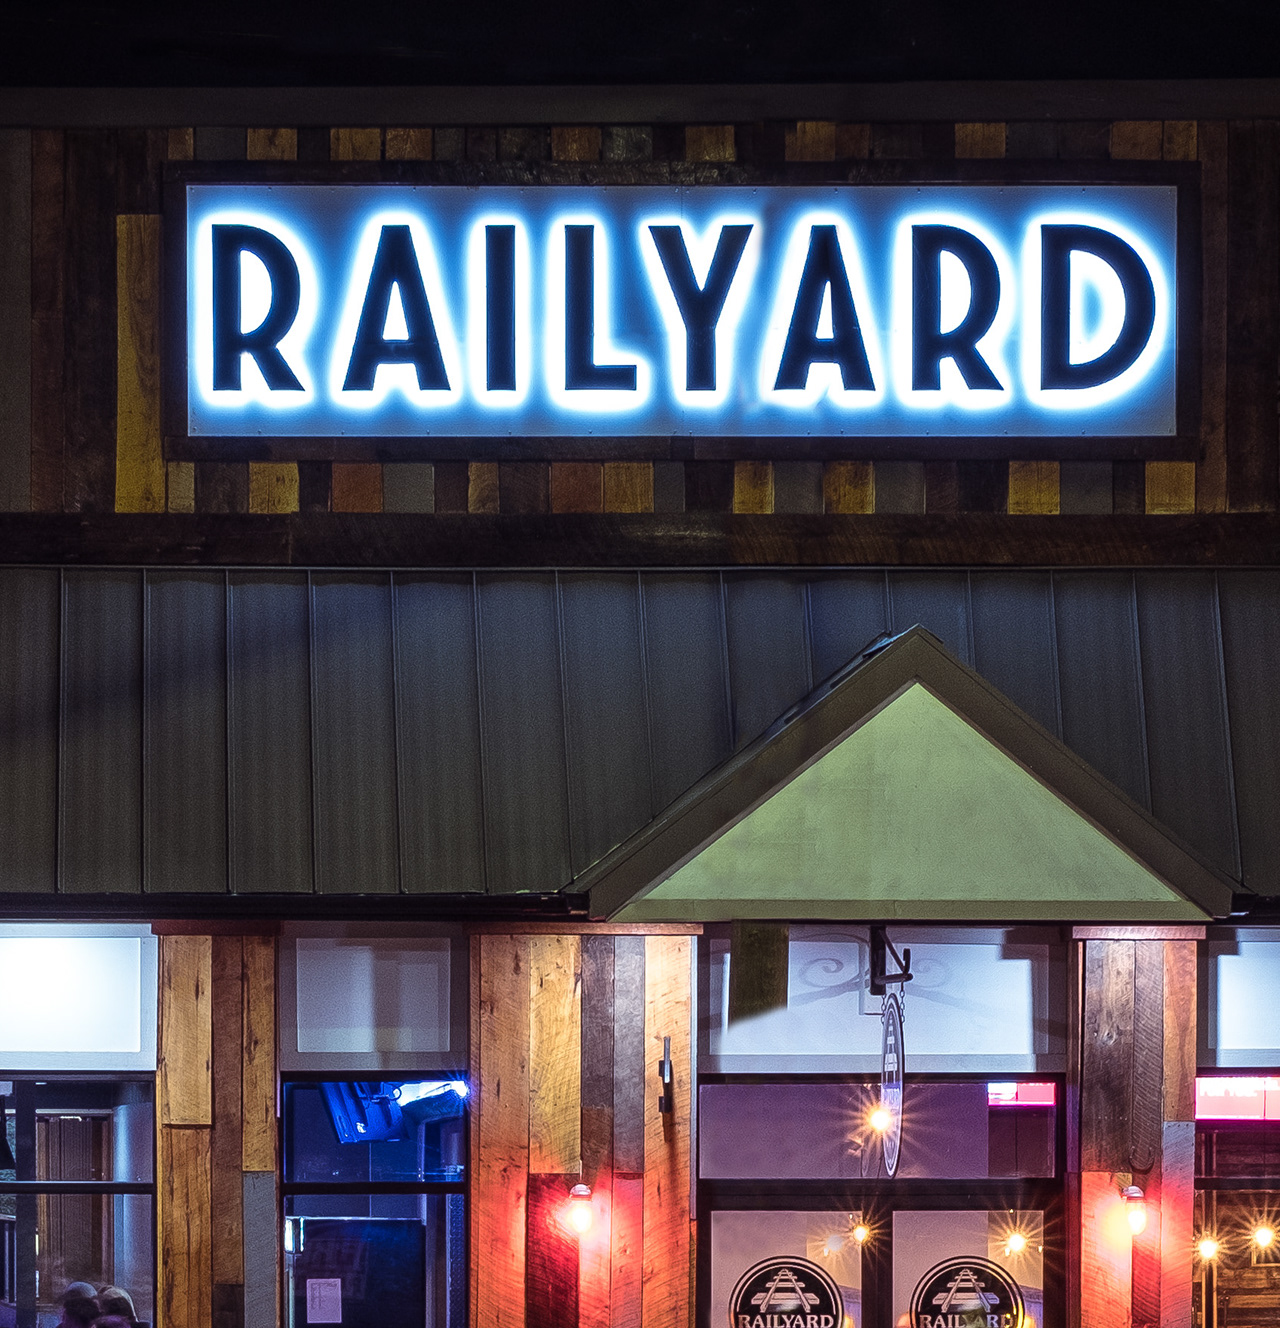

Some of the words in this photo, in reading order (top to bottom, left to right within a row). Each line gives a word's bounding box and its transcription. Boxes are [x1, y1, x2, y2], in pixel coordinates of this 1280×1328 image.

[210, 223, 1158, 392] RAILYARD
[737, 1314, 835, 1328] RAILYARD
[919, 1314, 1014, 1328] RAILYARD
